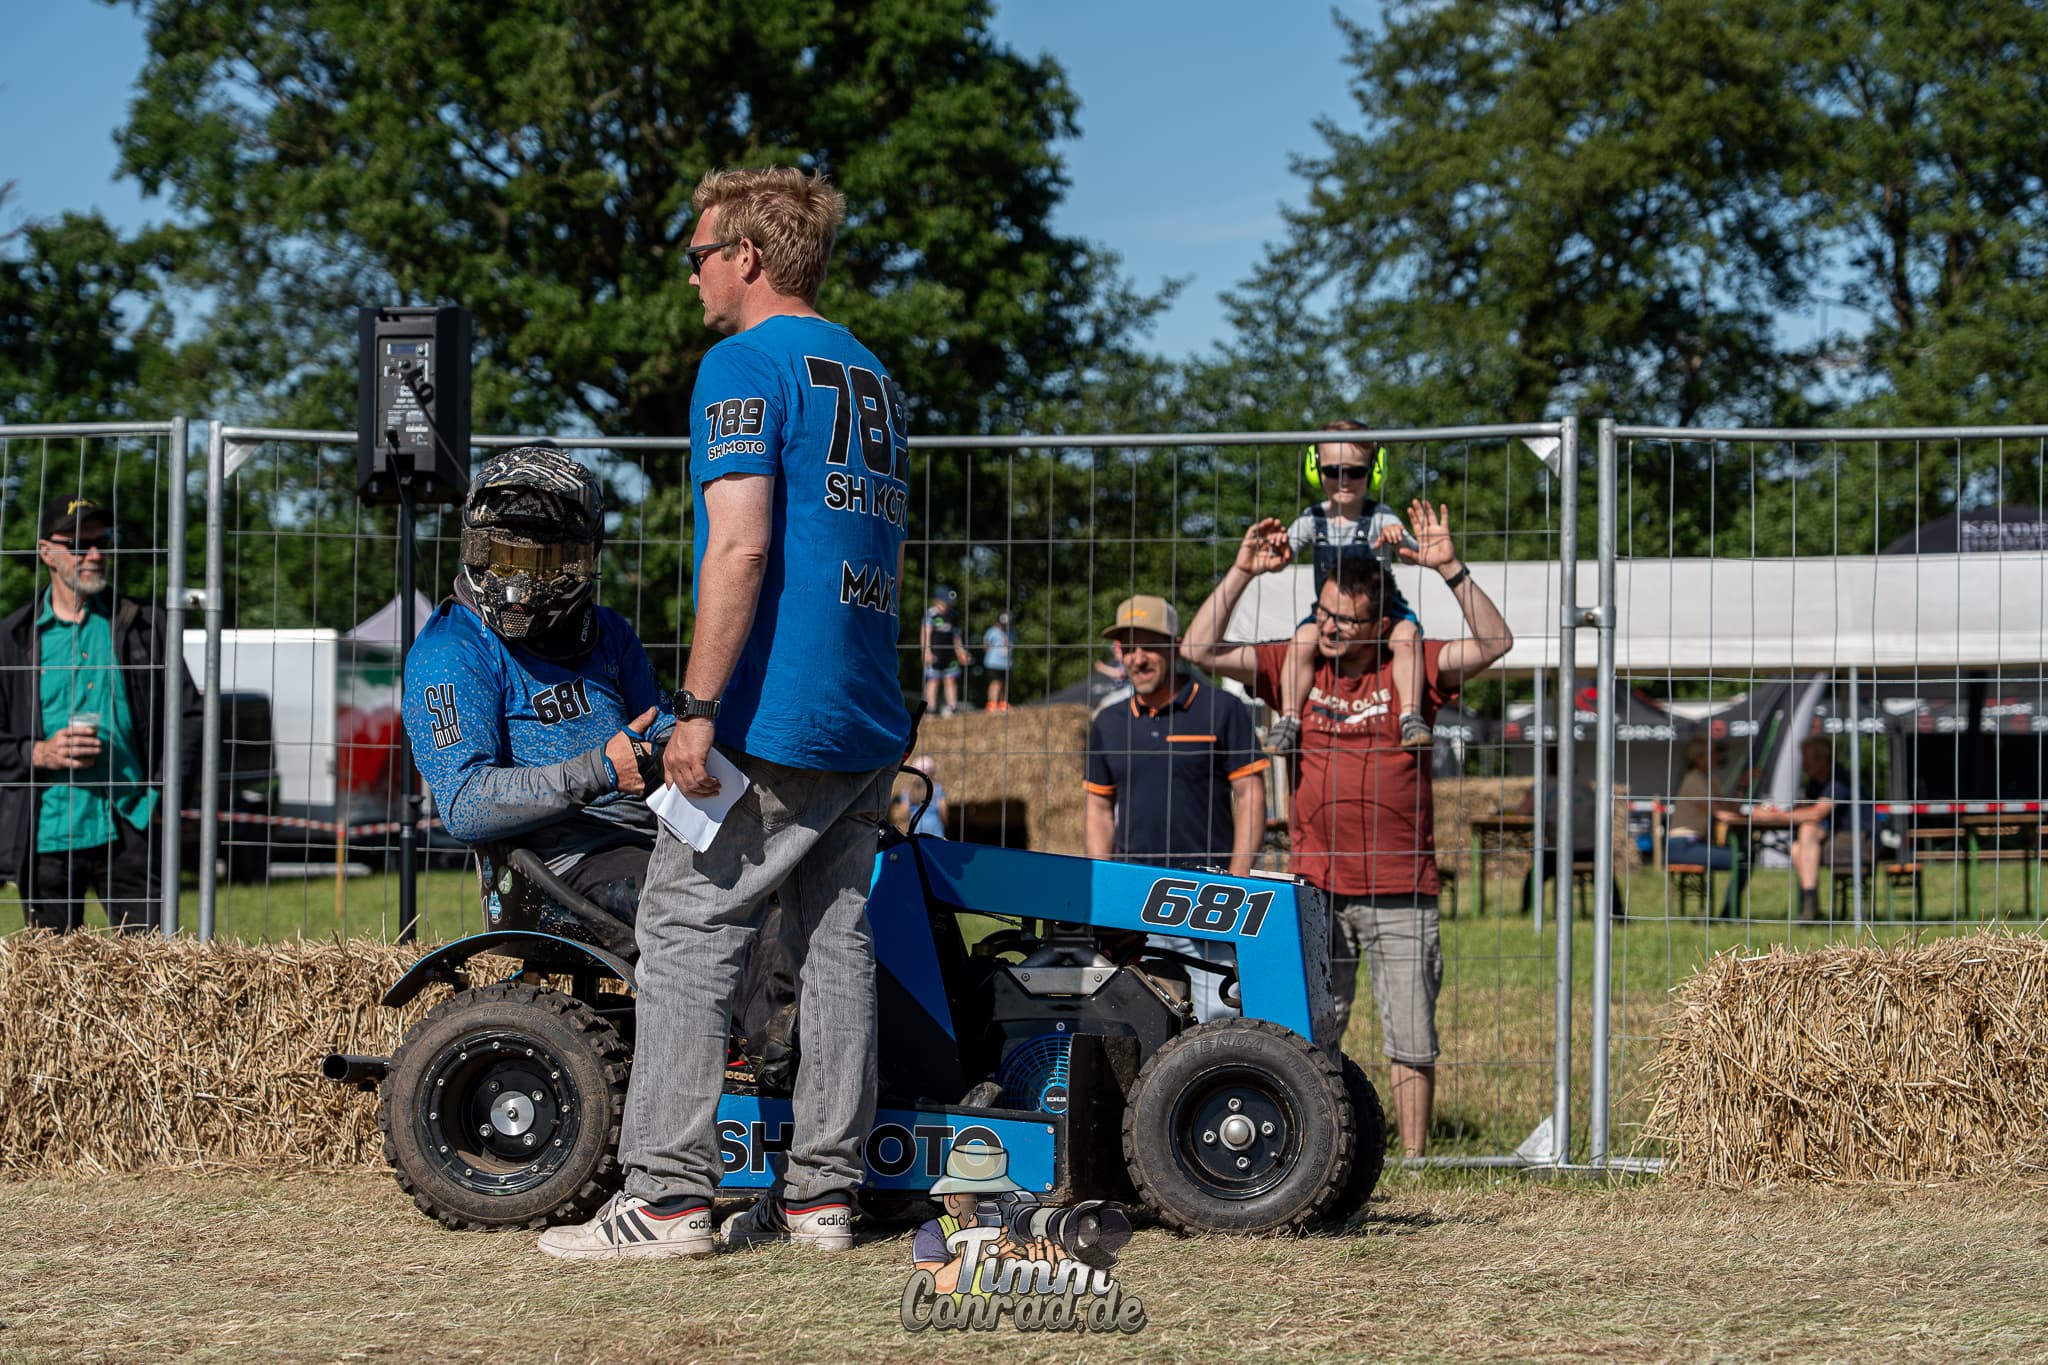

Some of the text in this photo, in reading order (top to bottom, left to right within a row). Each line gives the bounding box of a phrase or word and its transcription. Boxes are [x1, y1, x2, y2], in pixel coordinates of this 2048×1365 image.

[705, 397, 766, 444] 789
[804, 355, 909, 486] 789
[708, 440, 766, 460] SH MOTO
[824, 471, 907, 533] SH MOT
[424, 683, 459, 732] SH
[532, 676, 592, 727] 681
[1140, 877, 1276, 938] 681
[716, 1119, 1003, 1180] SH OTO
